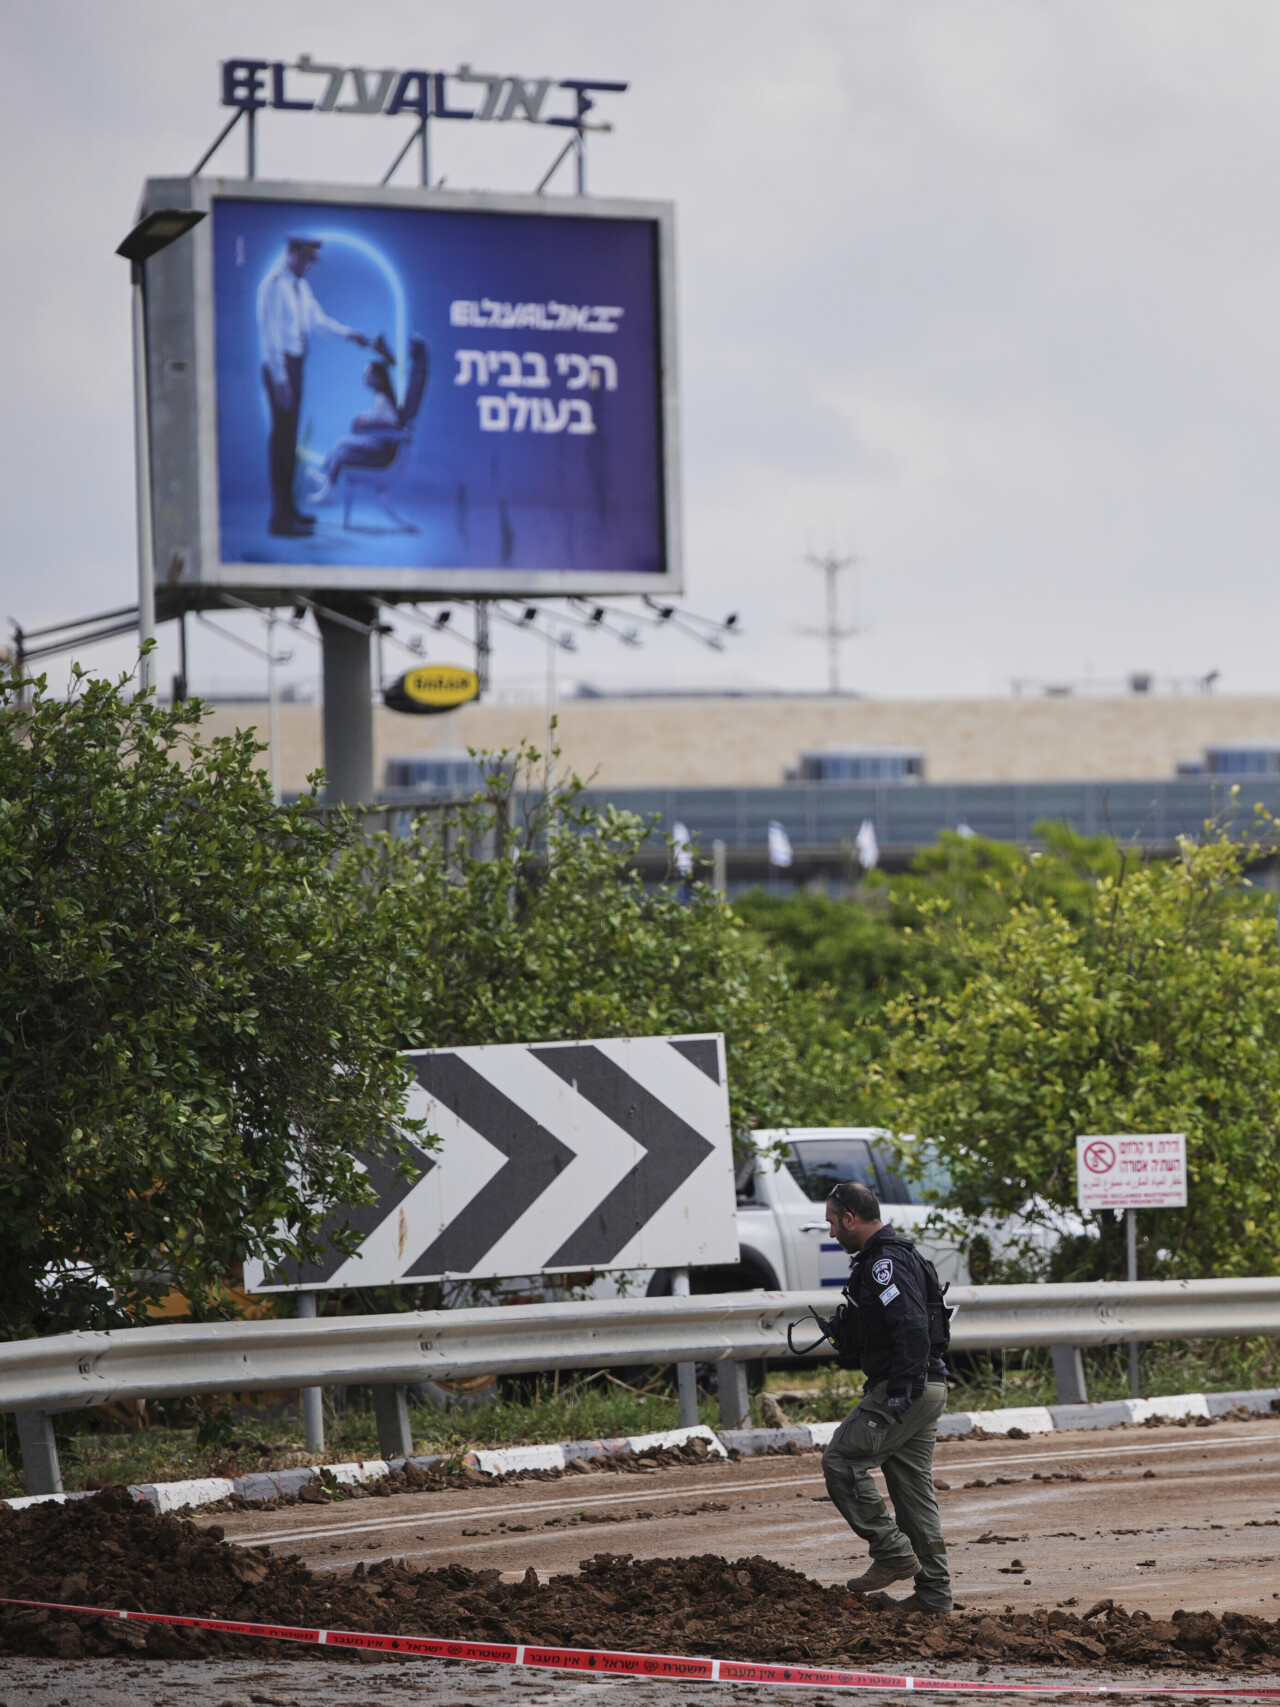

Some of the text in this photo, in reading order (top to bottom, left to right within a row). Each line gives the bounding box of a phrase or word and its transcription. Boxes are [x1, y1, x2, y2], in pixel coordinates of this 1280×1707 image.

[454, 349, 618, 391] הכי בבית
[477, 391, 597, 435] בעולם
[268, 1630, 314, 1640] משטרת
[332, 1635, 511, 1659] משטרת ישראל אין מעבר
[529, 1653, 707, 1674] משטרת ישראל אין מעבר
[725, 1666, 901, 1684] משטרת ישראל אין מעבר
